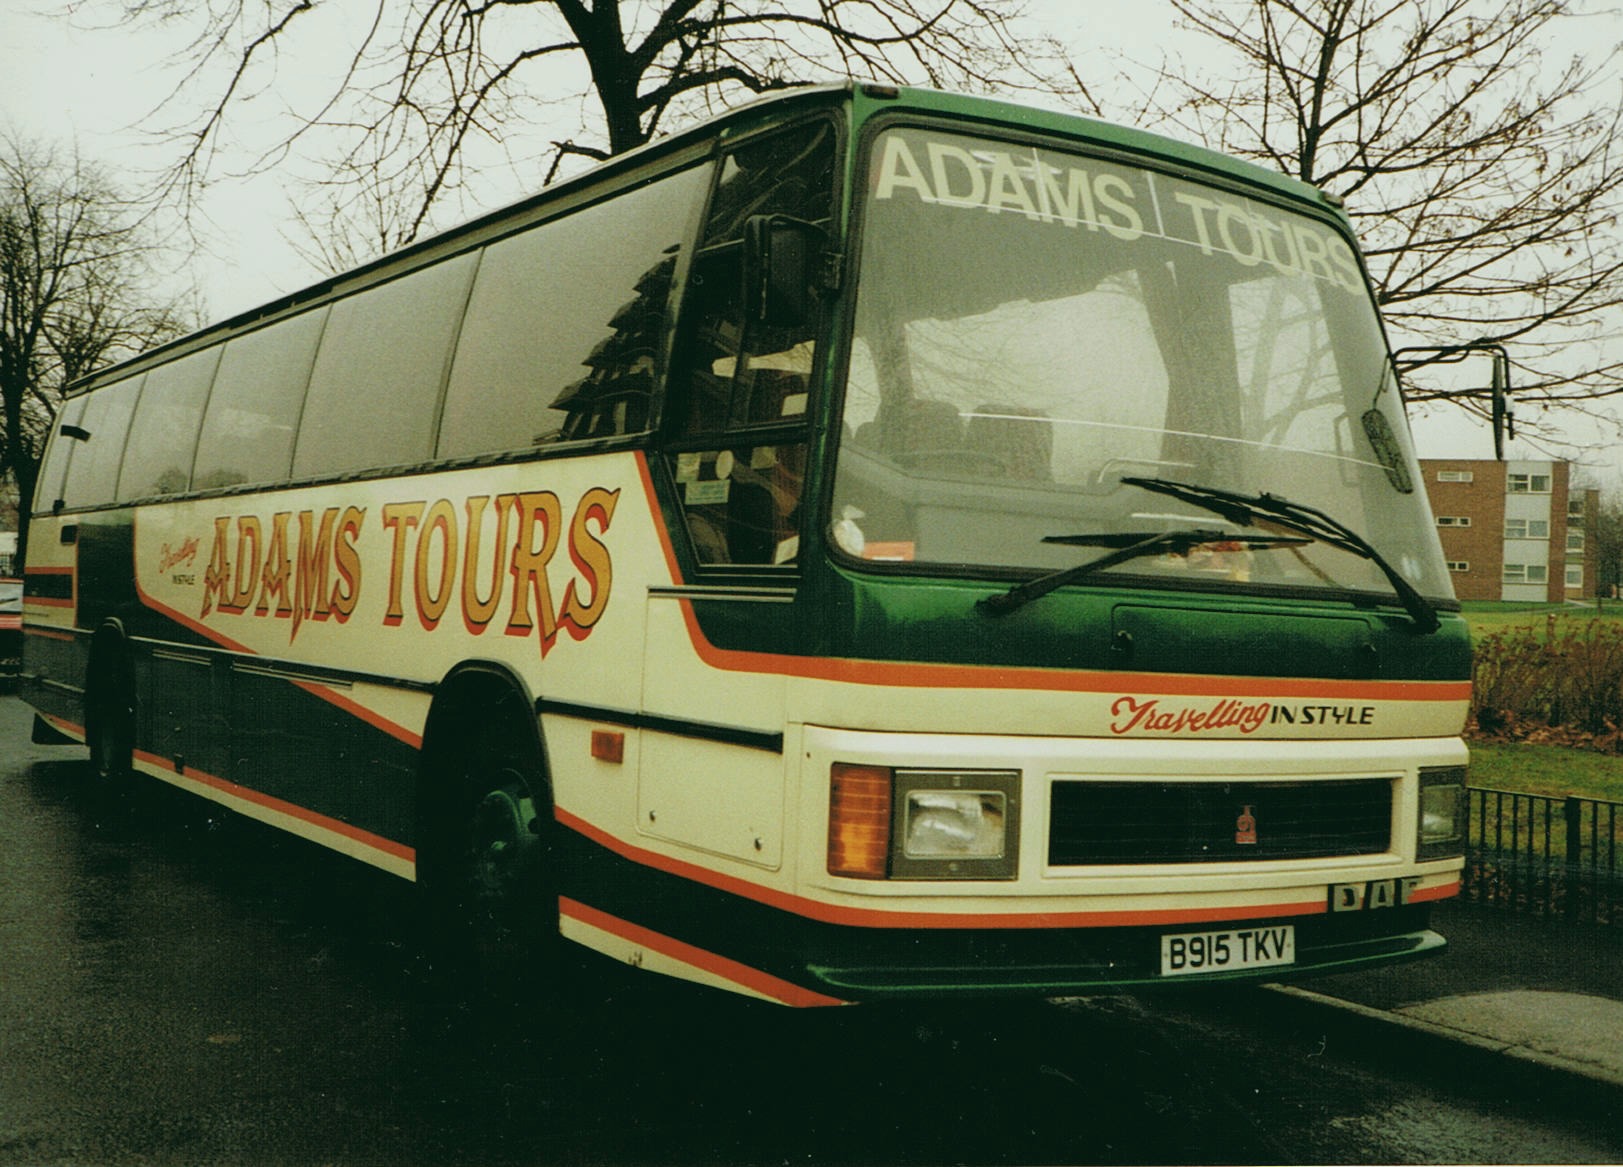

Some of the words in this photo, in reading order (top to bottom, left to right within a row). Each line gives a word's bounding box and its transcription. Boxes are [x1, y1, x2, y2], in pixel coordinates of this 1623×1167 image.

[875, 137, 1144, 241] ADAMS
[1175, 192, 1367, 297] TOURS
[201, 505, 367, 646] ADAMS
[382, 487, 621, 660] TOURS
[1111, 696, 1270, 734] Travelling
[1332, 878, 1424, 912] DAF
[1170, 934, 1230, 970] B915
[1238, 928, 1287, 963] TKV
